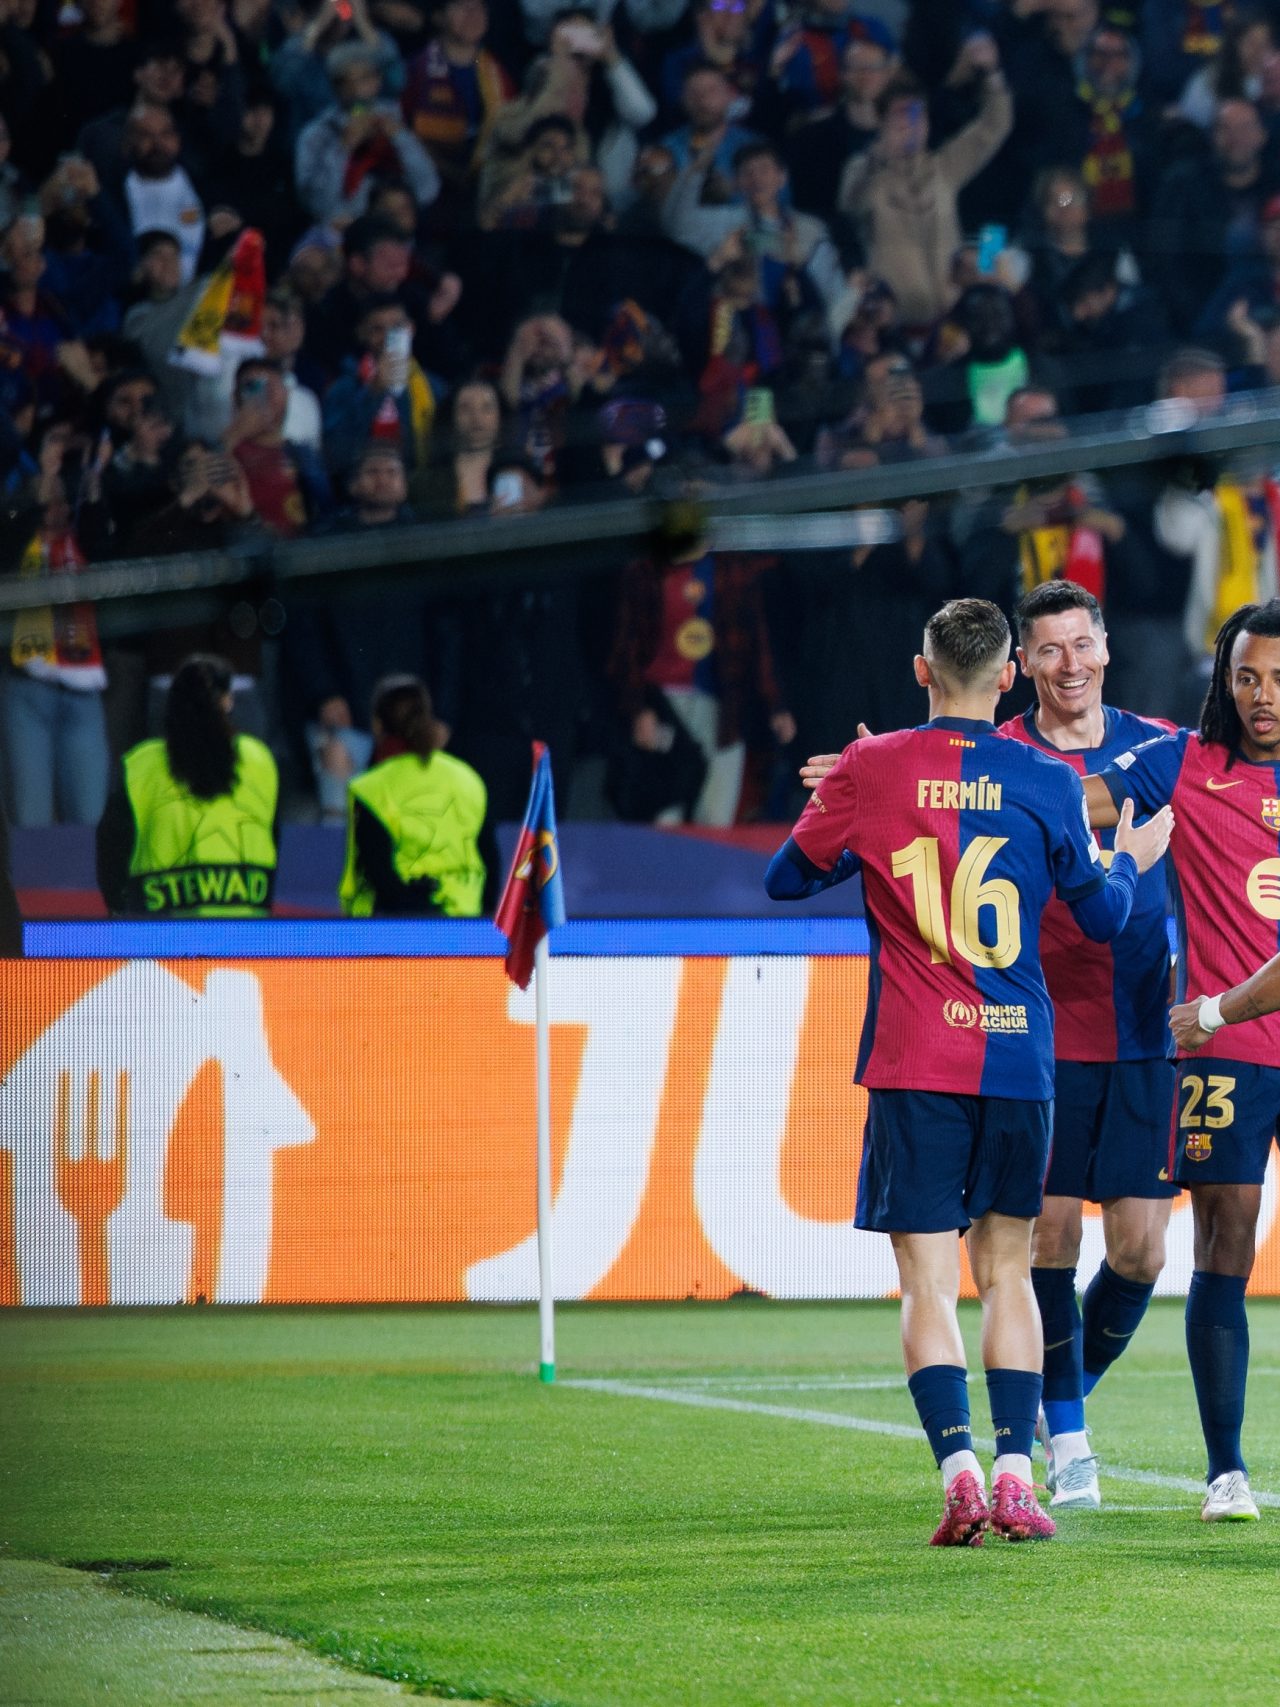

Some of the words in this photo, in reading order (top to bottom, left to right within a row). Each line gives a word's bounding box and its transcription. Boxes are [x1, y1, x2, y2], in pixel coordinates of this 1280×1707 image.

[917, 774, 1003, 811] FERMÍN
[891, 836, 1022, 969] 16
[979, 1004, 1027, 1017] UNHCR
[979, 1016, 1029, 1029] ACNUR
[1180, 1074, 1237, 1129] 23
